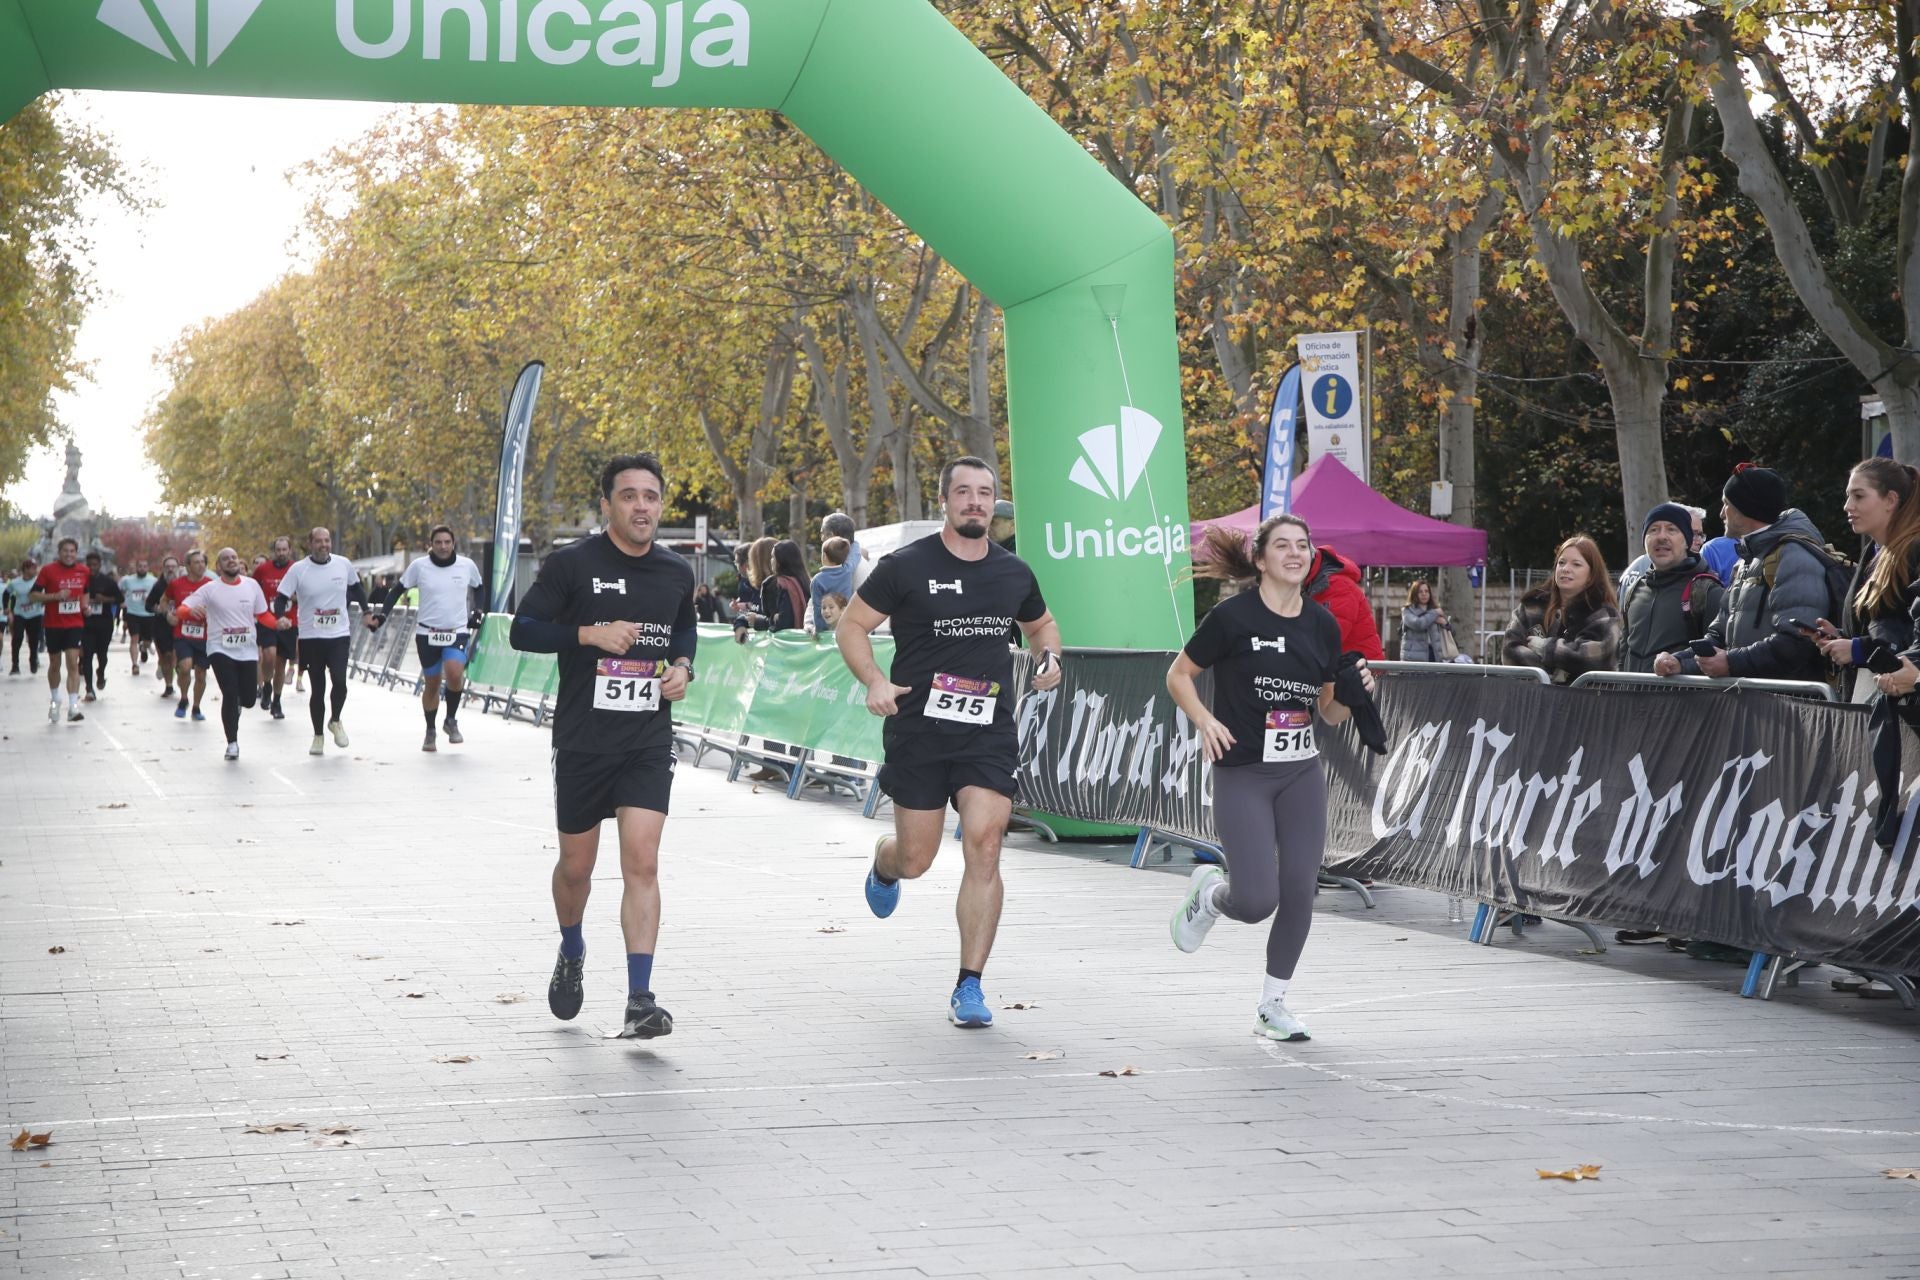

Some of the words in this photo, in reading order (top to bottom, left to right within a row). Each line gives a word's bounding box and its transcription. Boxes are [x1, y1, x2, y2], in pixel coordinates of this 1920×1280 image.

[335, 0, 750, 88] Unicaja
[1305, 341, 1330, 350] Oficina
[1331, 341, 1341, 349] de
[1269, 408, 1292, 516] VECO
[1045, 515, 1185, 565] Unicaja
[317, 616, 337, 625] 479
[933, 617, 1013, 628] #POWERING
[432, 633, 452, 642] 480
[605, 679, 652, 701] 514
[936, 693, 985, 716] 515
[1057, 688, 1164, 790] Norte
[1274, 728, 1311, 752] 516
[1372, 719, 1451, 841] El
[1445, 717, 1602, 870] Norte
[1602, 752, 1683, 880] de
[1686, 749, 1920, 920] Castill
